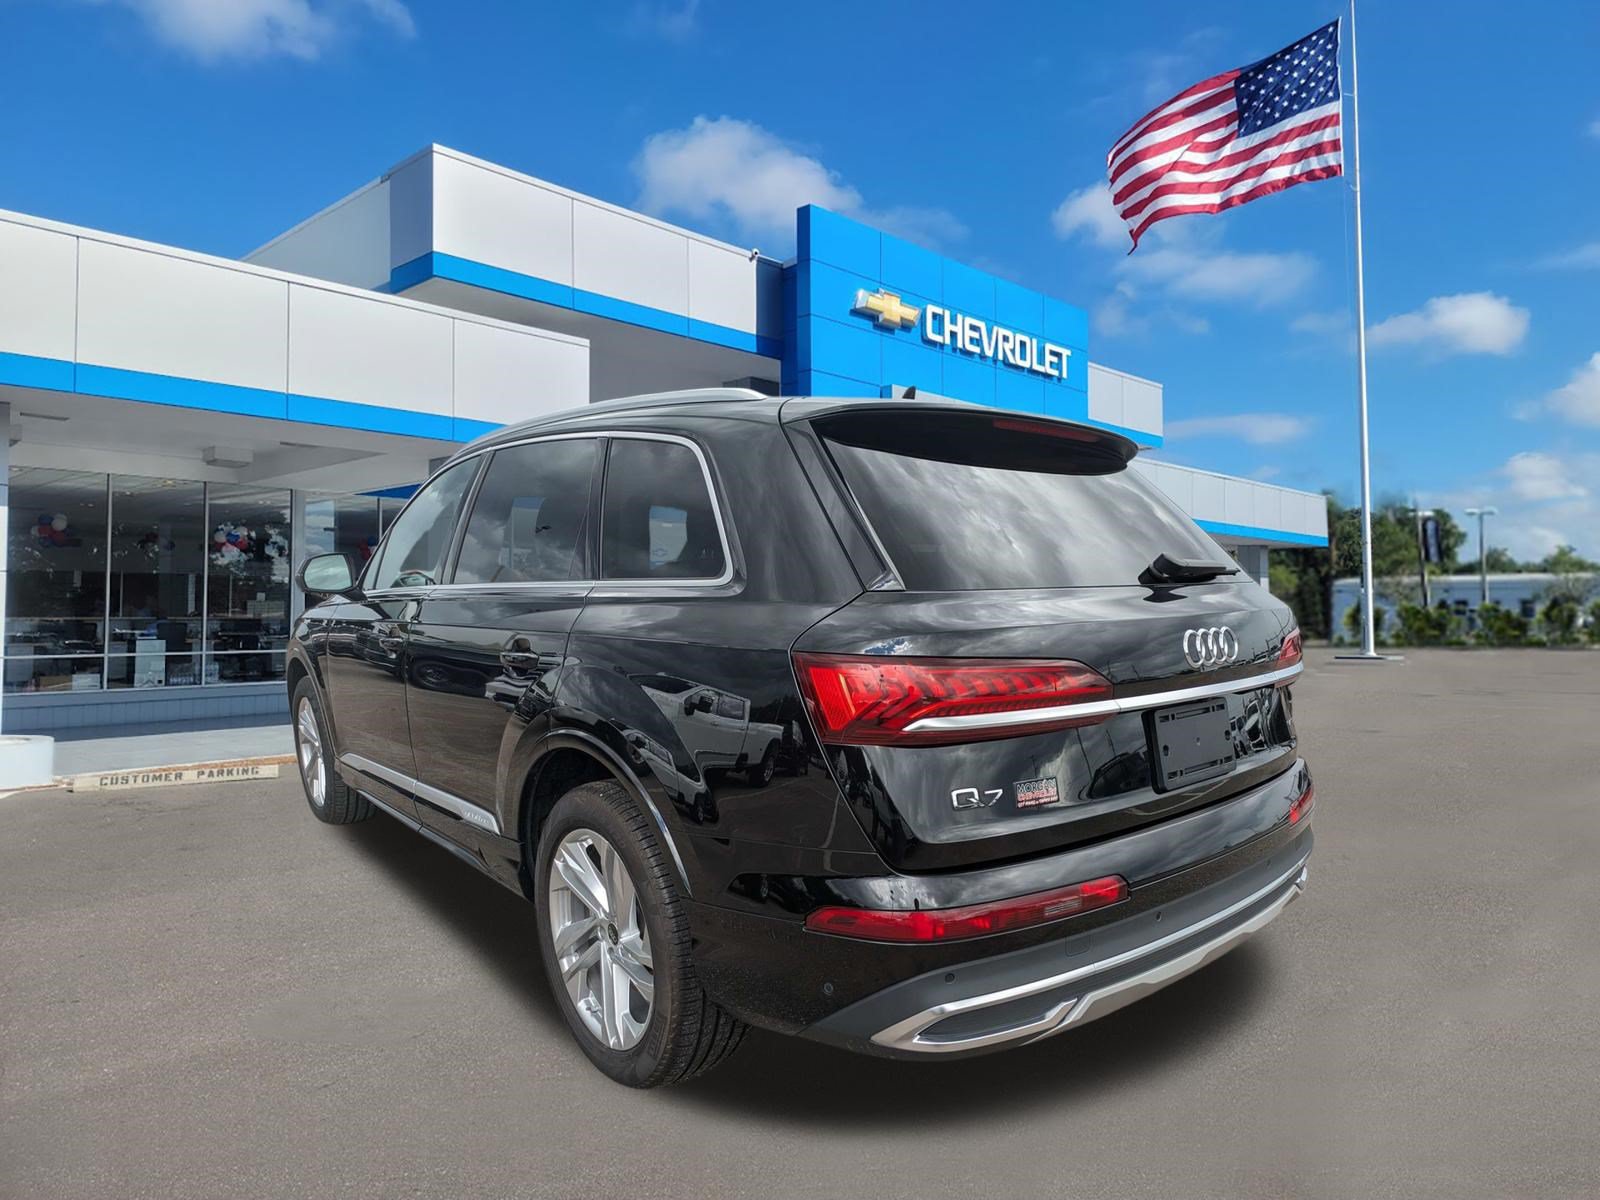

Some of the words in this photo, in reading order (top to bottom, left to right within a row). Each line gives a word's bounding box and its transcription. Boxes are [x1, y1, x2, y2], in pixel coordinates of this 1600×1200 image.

[925, 304, 1071, 379] CHEVROLET
[98, 772, 184, 787] CUSTOMER
[196, 766, 260, 779] PARKING
[1016, 778, 1057, 795] MORGAN
[951, 787, 1004, 809] Q7
